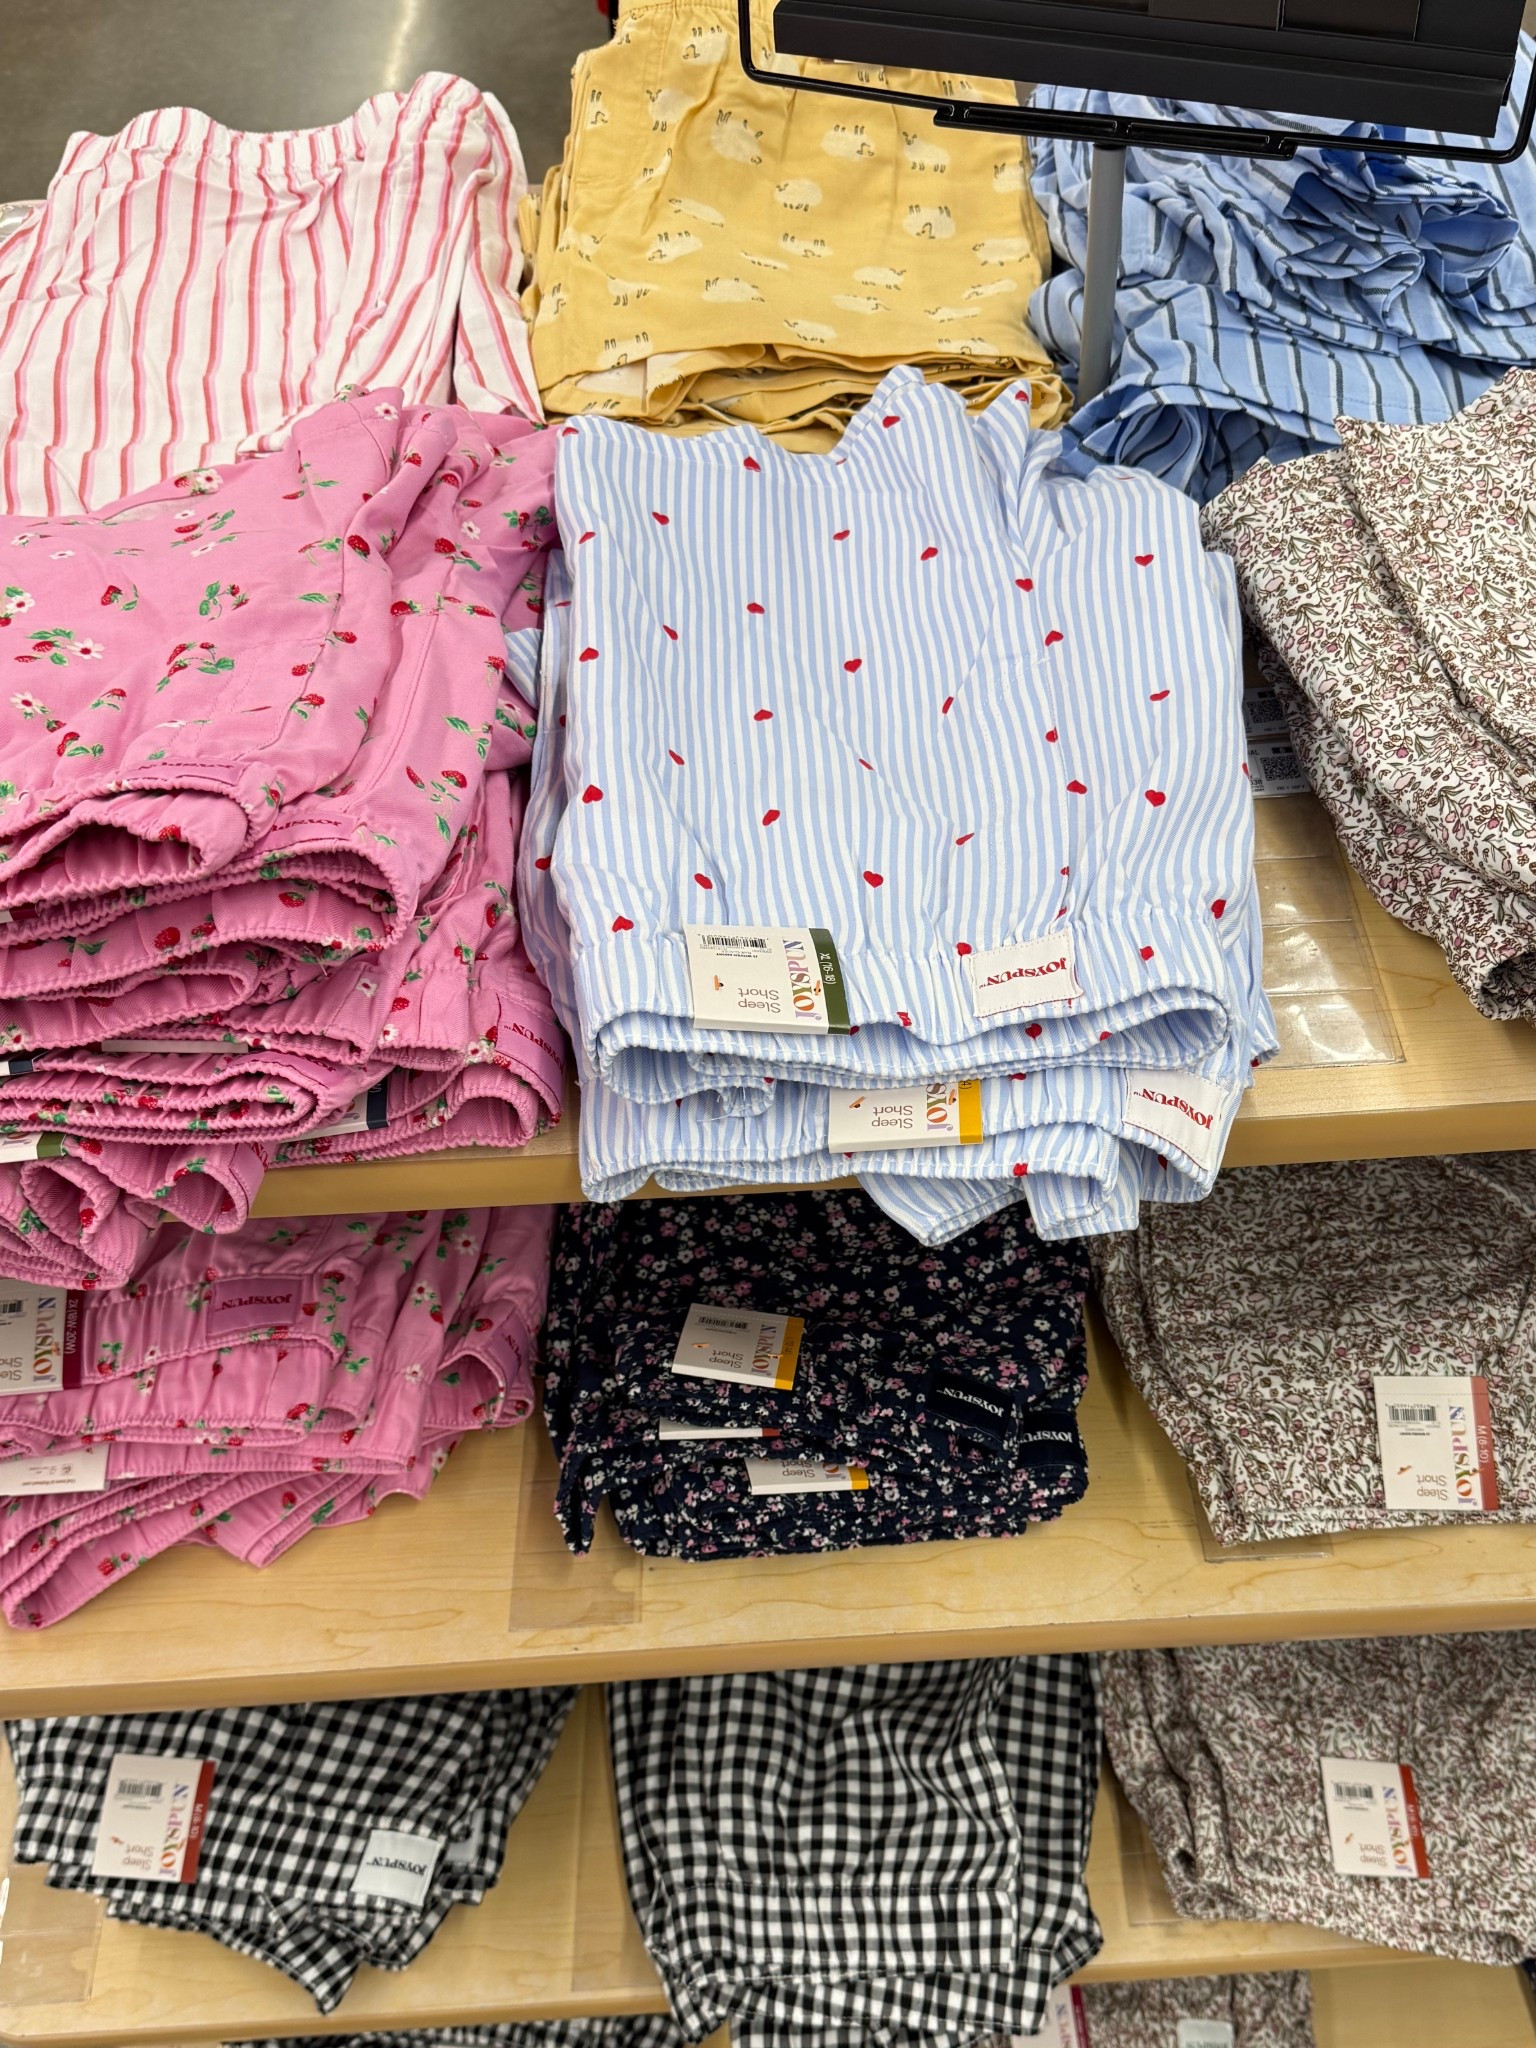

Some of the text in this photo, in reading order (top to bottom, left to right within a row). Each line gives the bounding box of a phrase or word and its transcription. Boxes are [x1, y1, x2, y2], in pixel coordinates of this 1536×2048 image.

[820, 952, 836, 985] XL (16-18)
[783, 939, 822, 1021] JOYSPUN
[738, 987, 780, 1000] Short
[738, 998, 781, 1014] Sleep
[873, 1105, 913, 1116] Short
[925, 1082, 954, 1131] JOYS
[871, 1117, 913, 1129] Sleep
[69, 1298, 79, 1307] 2X
[33, 1297, 57, 1382] JOYSPUN
[712, 1349, 744, 1361] Short
[751, 1324, 777, 1376] JOYSPUN
[709, 1356, 742, 1369] Sleep
[1477, 1425, 1489, 1463] M (8-10)
[1448, 1405, 1478, 1506] JOYSPUN
[782, 1468, 816, 1478] Sleep
[1416, 1474, 1447, 1487] Short
[1416, 1486, 1448, 1501] Sleep
[159, 1784, 189, 1878] JOYSPUN
[1382, 1786, 1413, 1873] JOYSPUN
[125, 1844, 154, 1857] Short
[1360, 1843, 1386, 1855] Short
[122, 1855, 152, 1870] Sleep
[1360, 1855, 1388, 1868] Sleep
